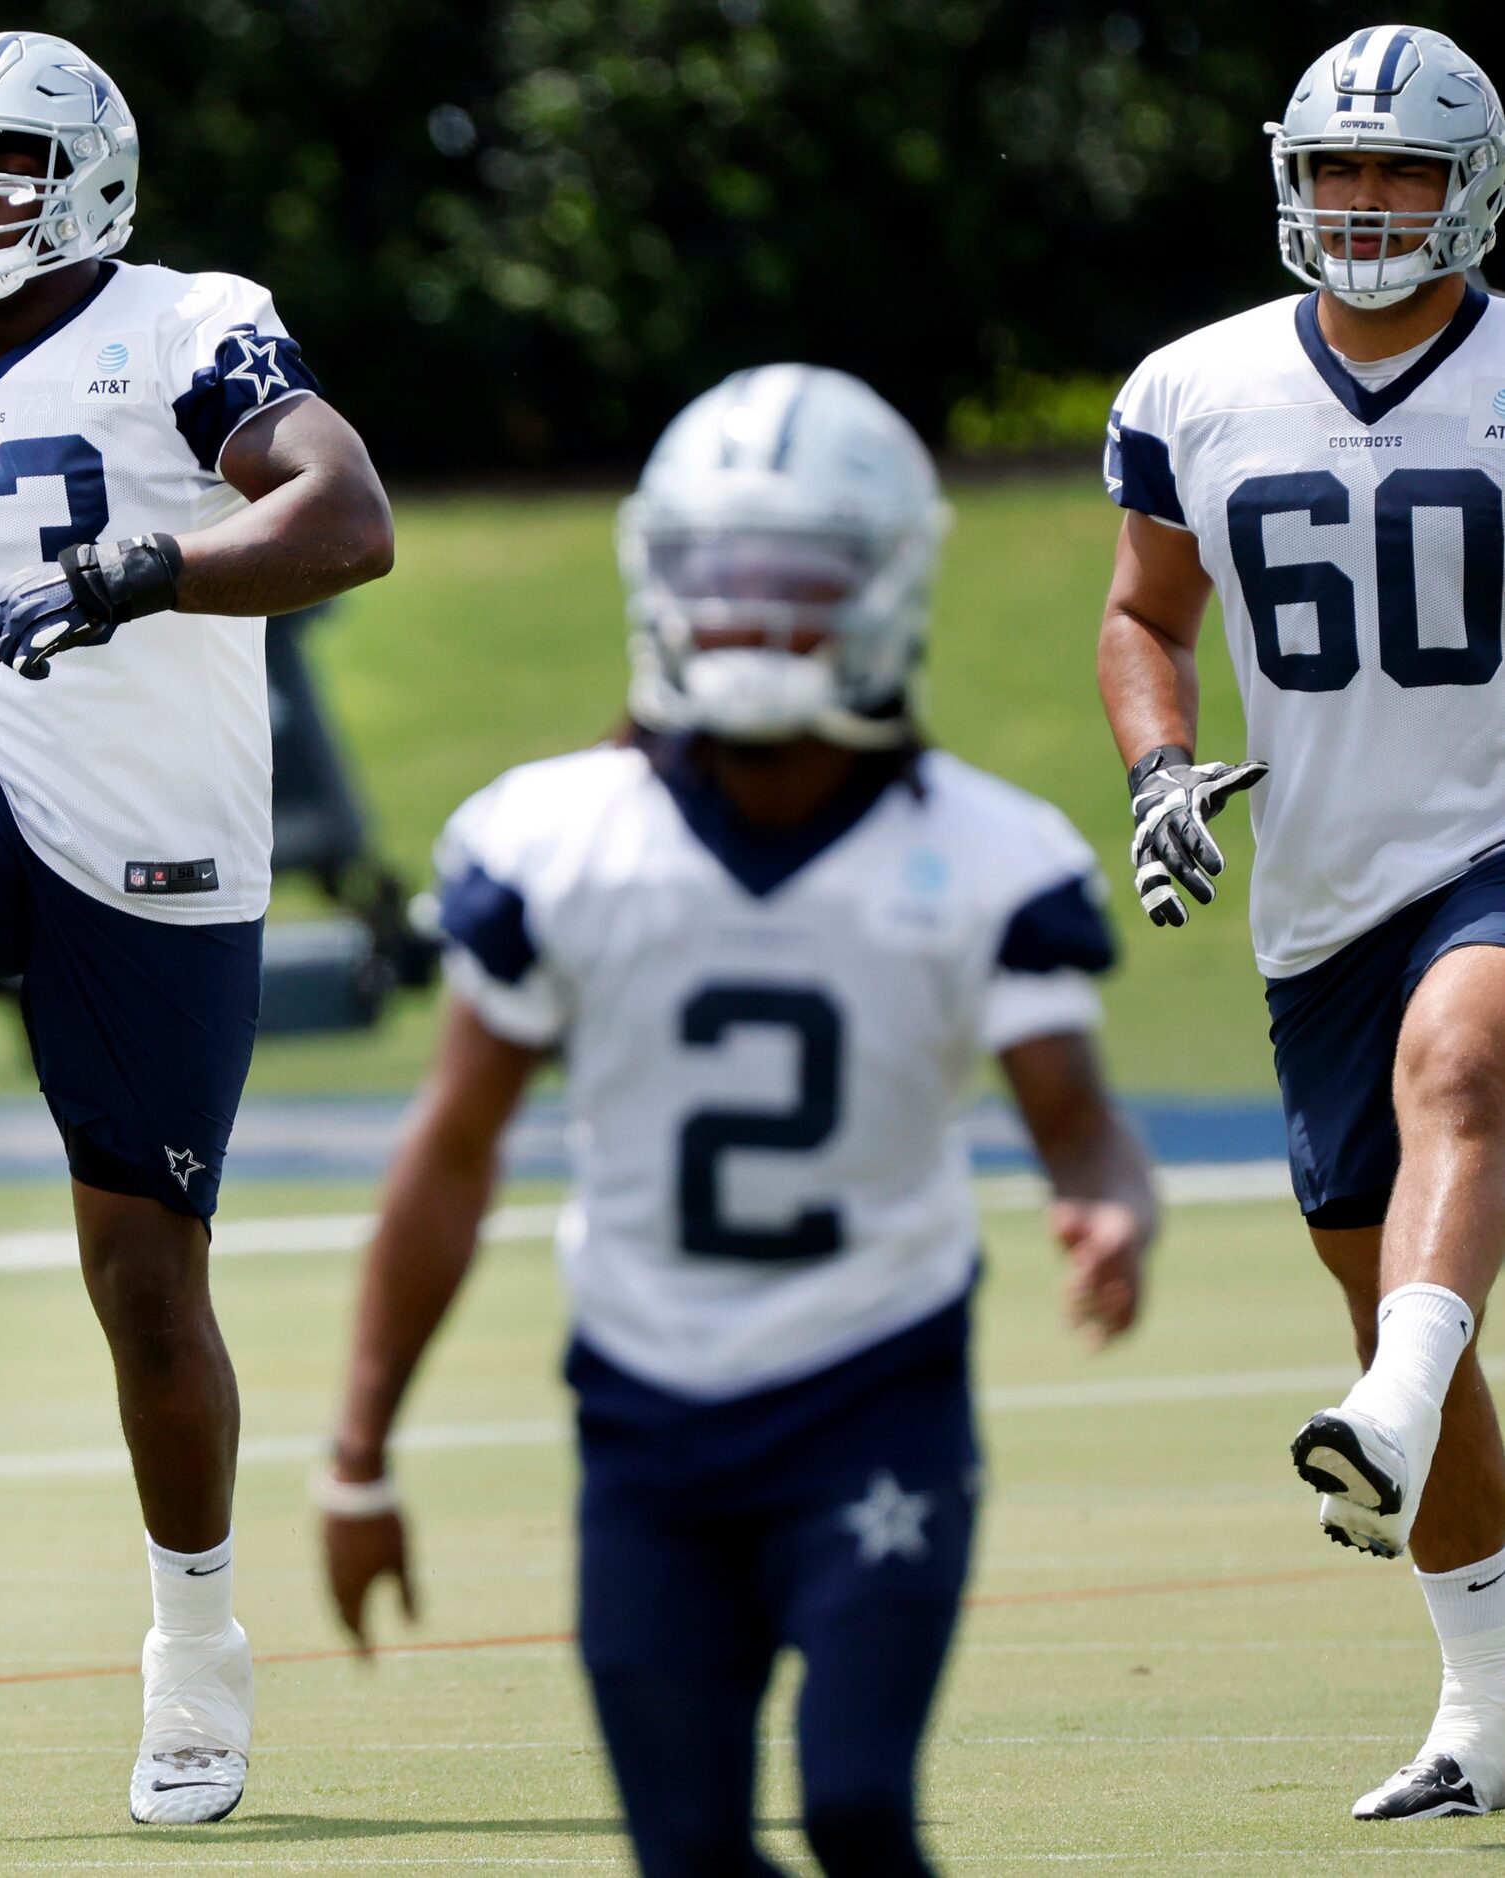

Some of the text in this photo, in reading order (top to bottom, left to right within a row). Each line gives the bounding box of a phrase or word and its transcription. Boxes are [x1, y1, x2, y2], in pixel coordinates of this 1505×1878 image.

[1340, 120, 1385, 130] COWBOYS
[87, 379, 131, 394] AT&T
[1328, 435, 1403, 449] COWBOYS
[1226, 468, 1504, 692] 60
[677, 980, 845, 1263] 2
